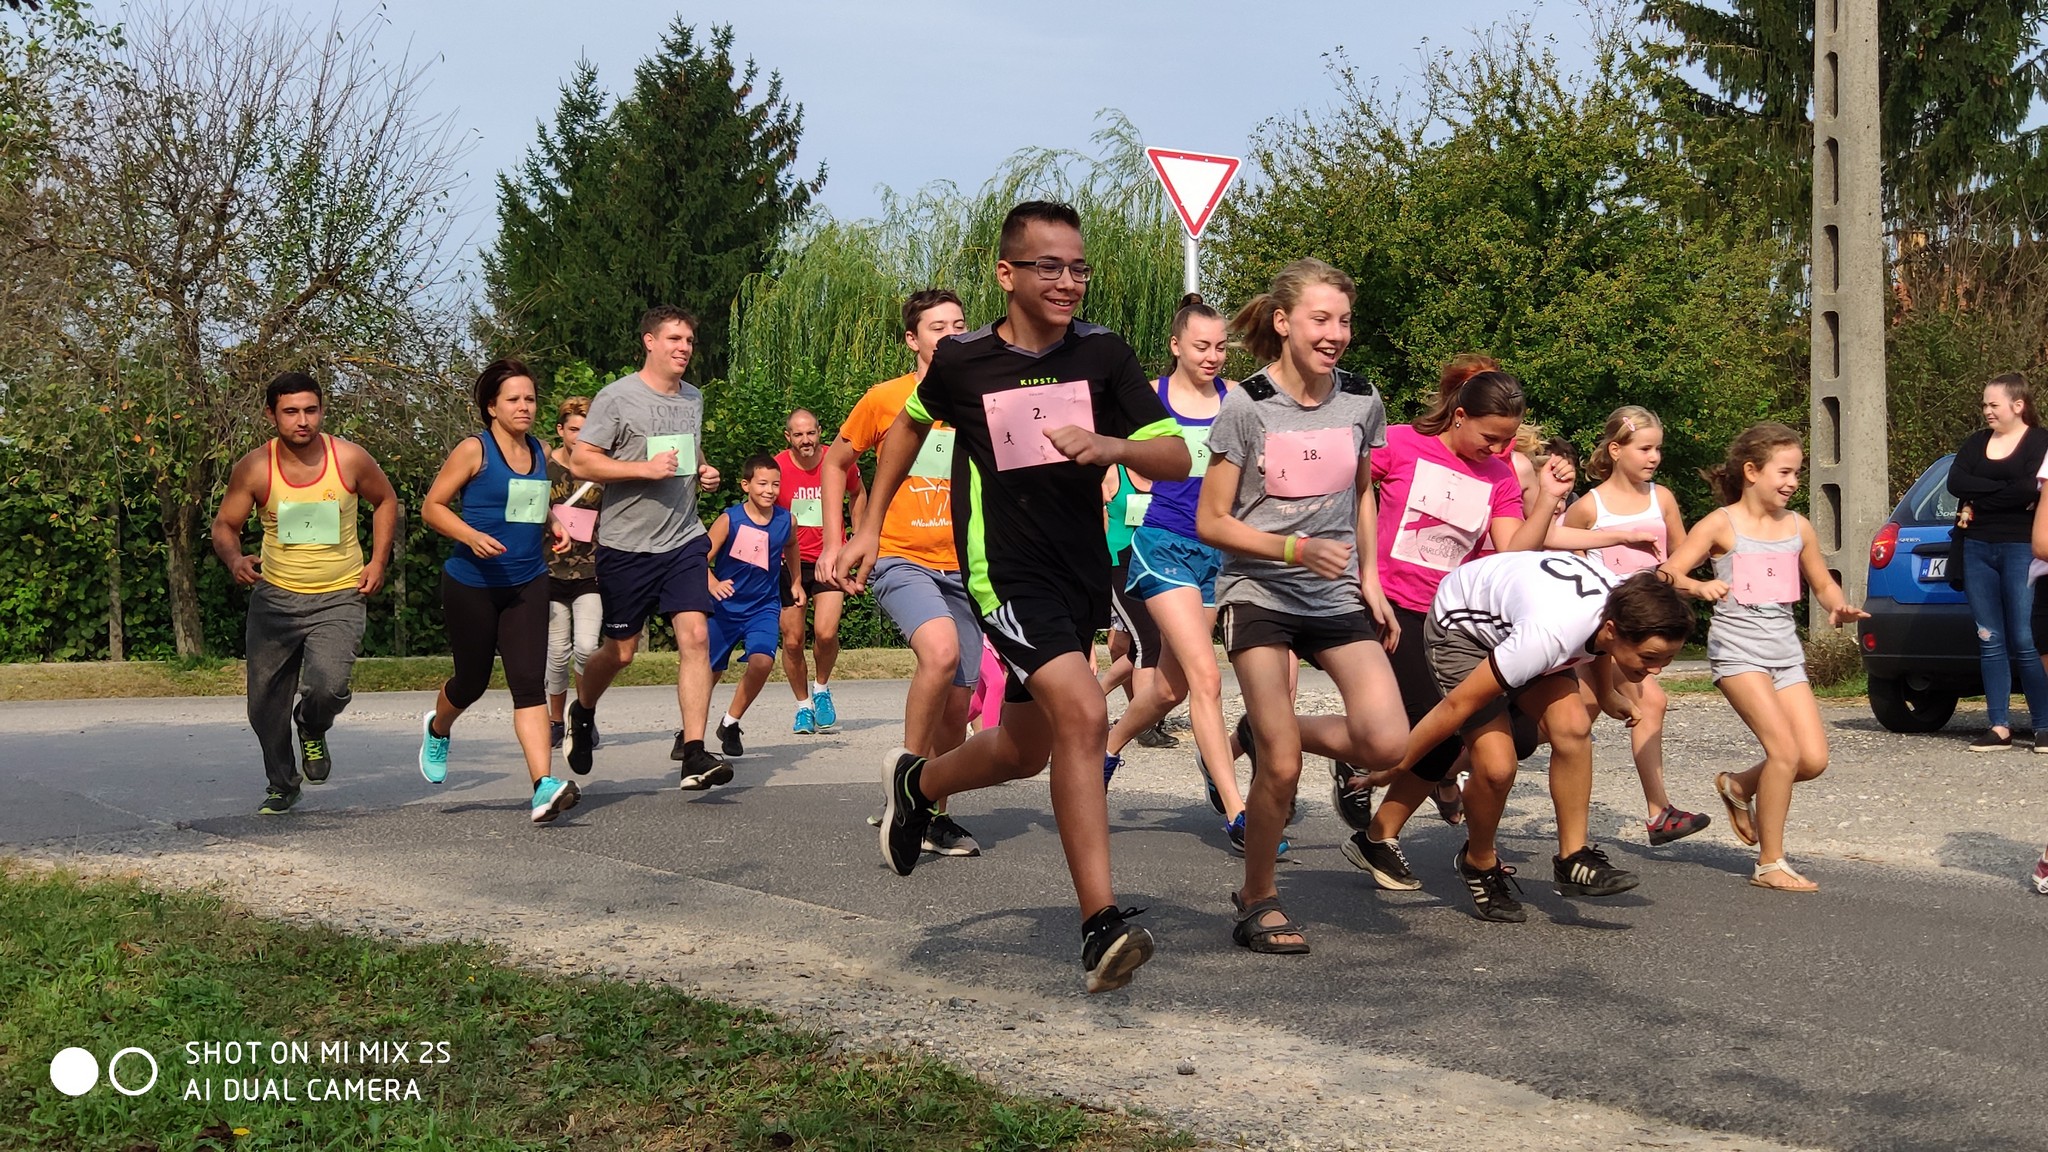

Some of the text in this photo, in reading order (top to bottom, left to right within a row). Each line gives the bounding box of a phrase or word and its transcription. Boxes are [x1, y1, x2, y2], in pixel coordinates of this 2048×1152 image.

[1020, 377, 1058, 386] KIPSTA
[1032, 407, 1047, 420] 2.
[649, 418, 697, 432] TAILOR
[935, 444, 945, 453] 6.
[1197, 449, 1206, 458] 5.
[1302, 449, 1322, 461] 18.
[1445, 491, 1455, 501] 1.
[304, 521, 313, 529] 7.
[1766, 567, 1776, 577] 8.
